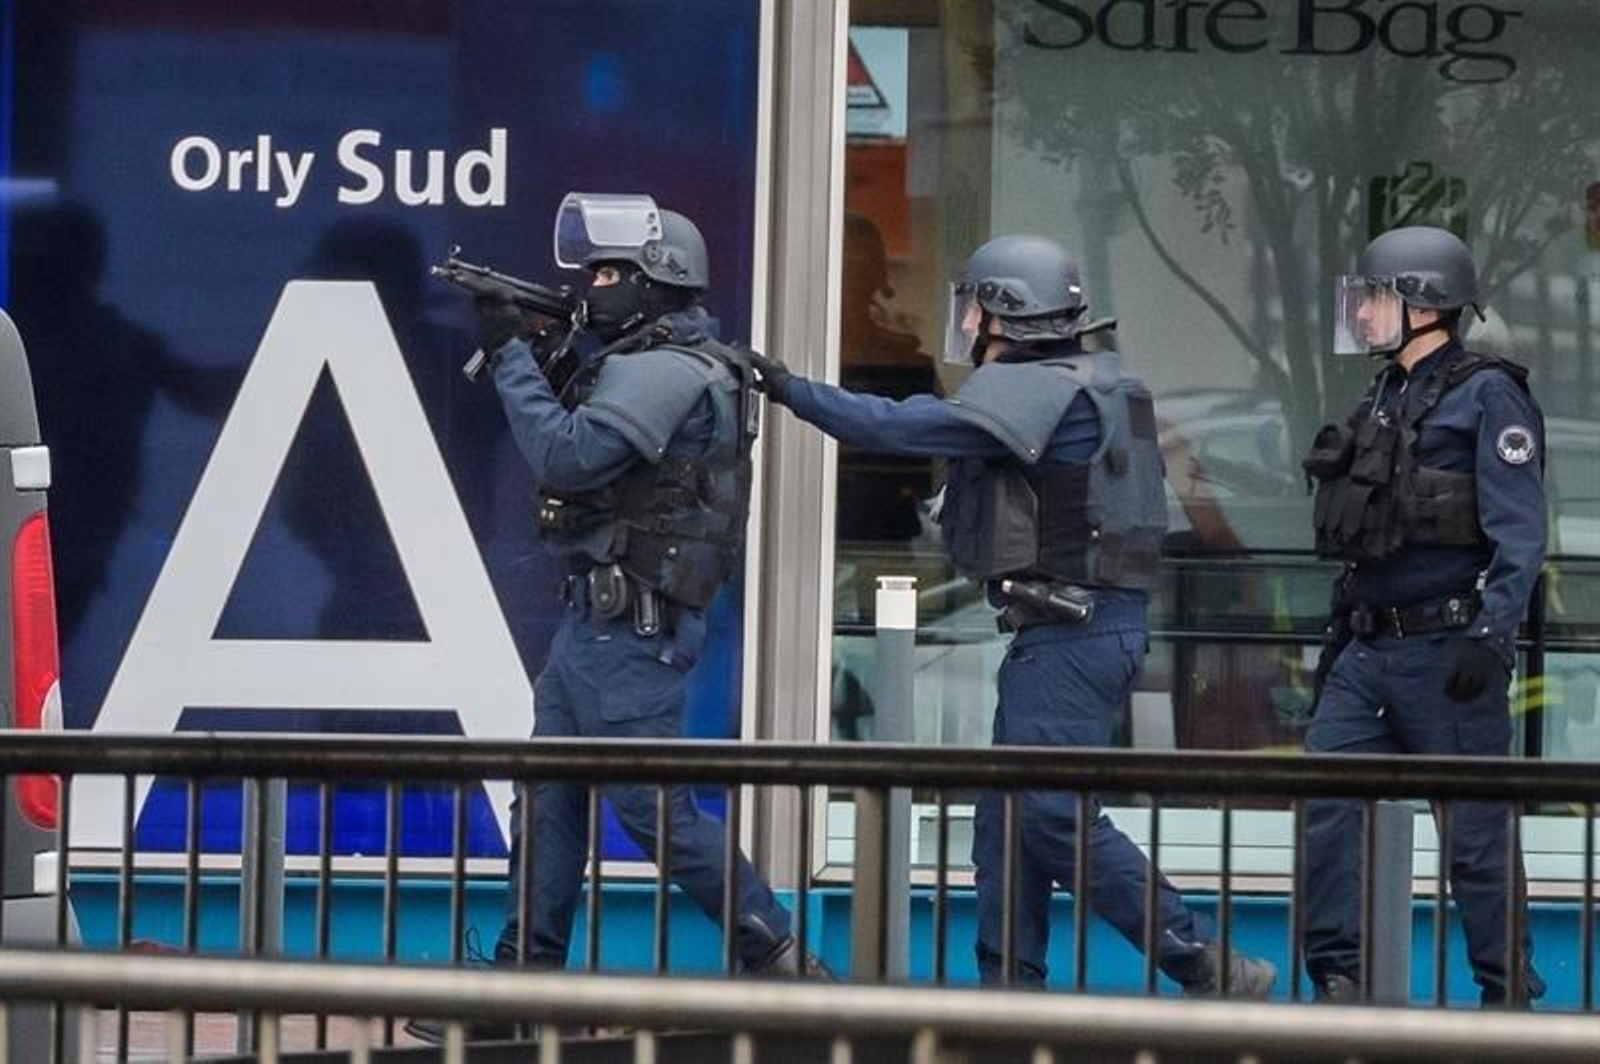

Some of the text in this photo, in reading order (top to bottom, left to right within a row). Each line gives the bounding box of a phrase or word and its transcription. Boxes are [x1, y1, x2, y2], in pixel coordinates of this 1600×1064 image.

[1023, 0, 1524, 84] Safe Bag
[170, 128, 508, 208] Orly Sud
[66, 280, 535, 850] A
